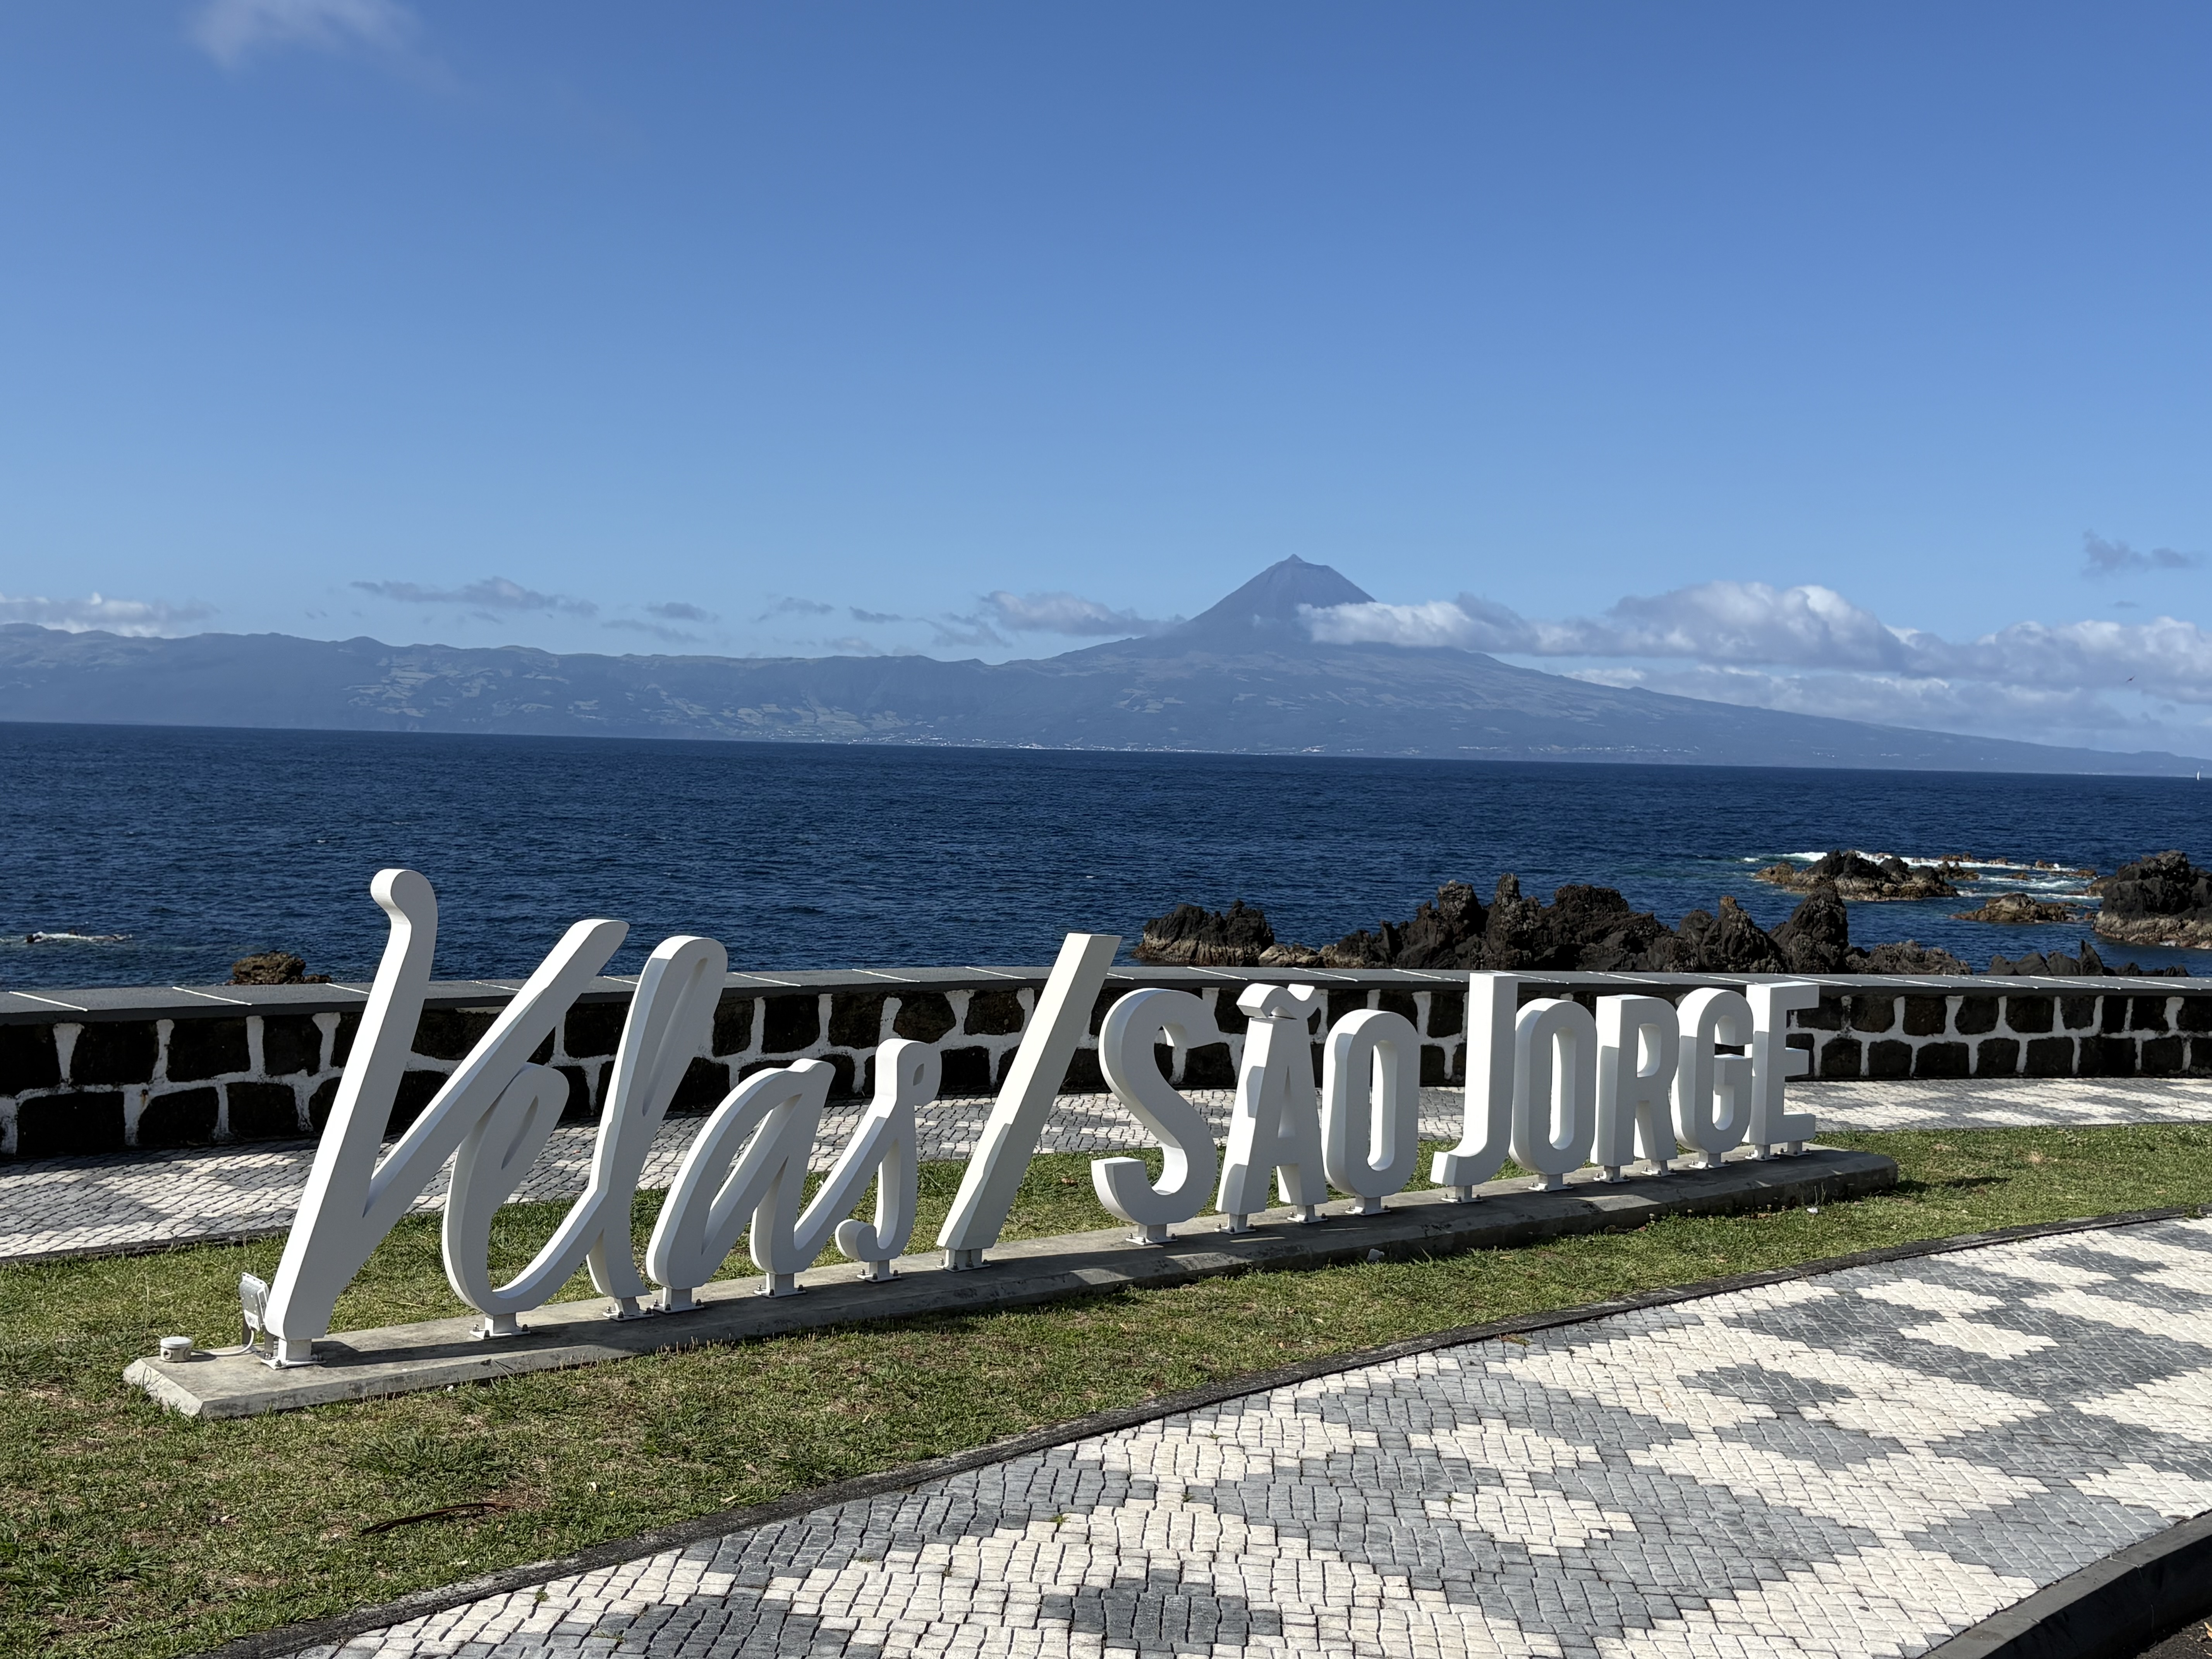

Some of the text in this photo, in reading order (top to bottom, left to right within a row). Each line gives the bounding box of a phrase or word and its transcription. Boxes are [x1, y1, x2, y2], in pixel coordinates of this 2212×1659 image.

[266, 869, 941, 1340] Velas
[1091, 983, 1421, 1226] SÃO
[1430, 972, 1819, 1187] JORGE
